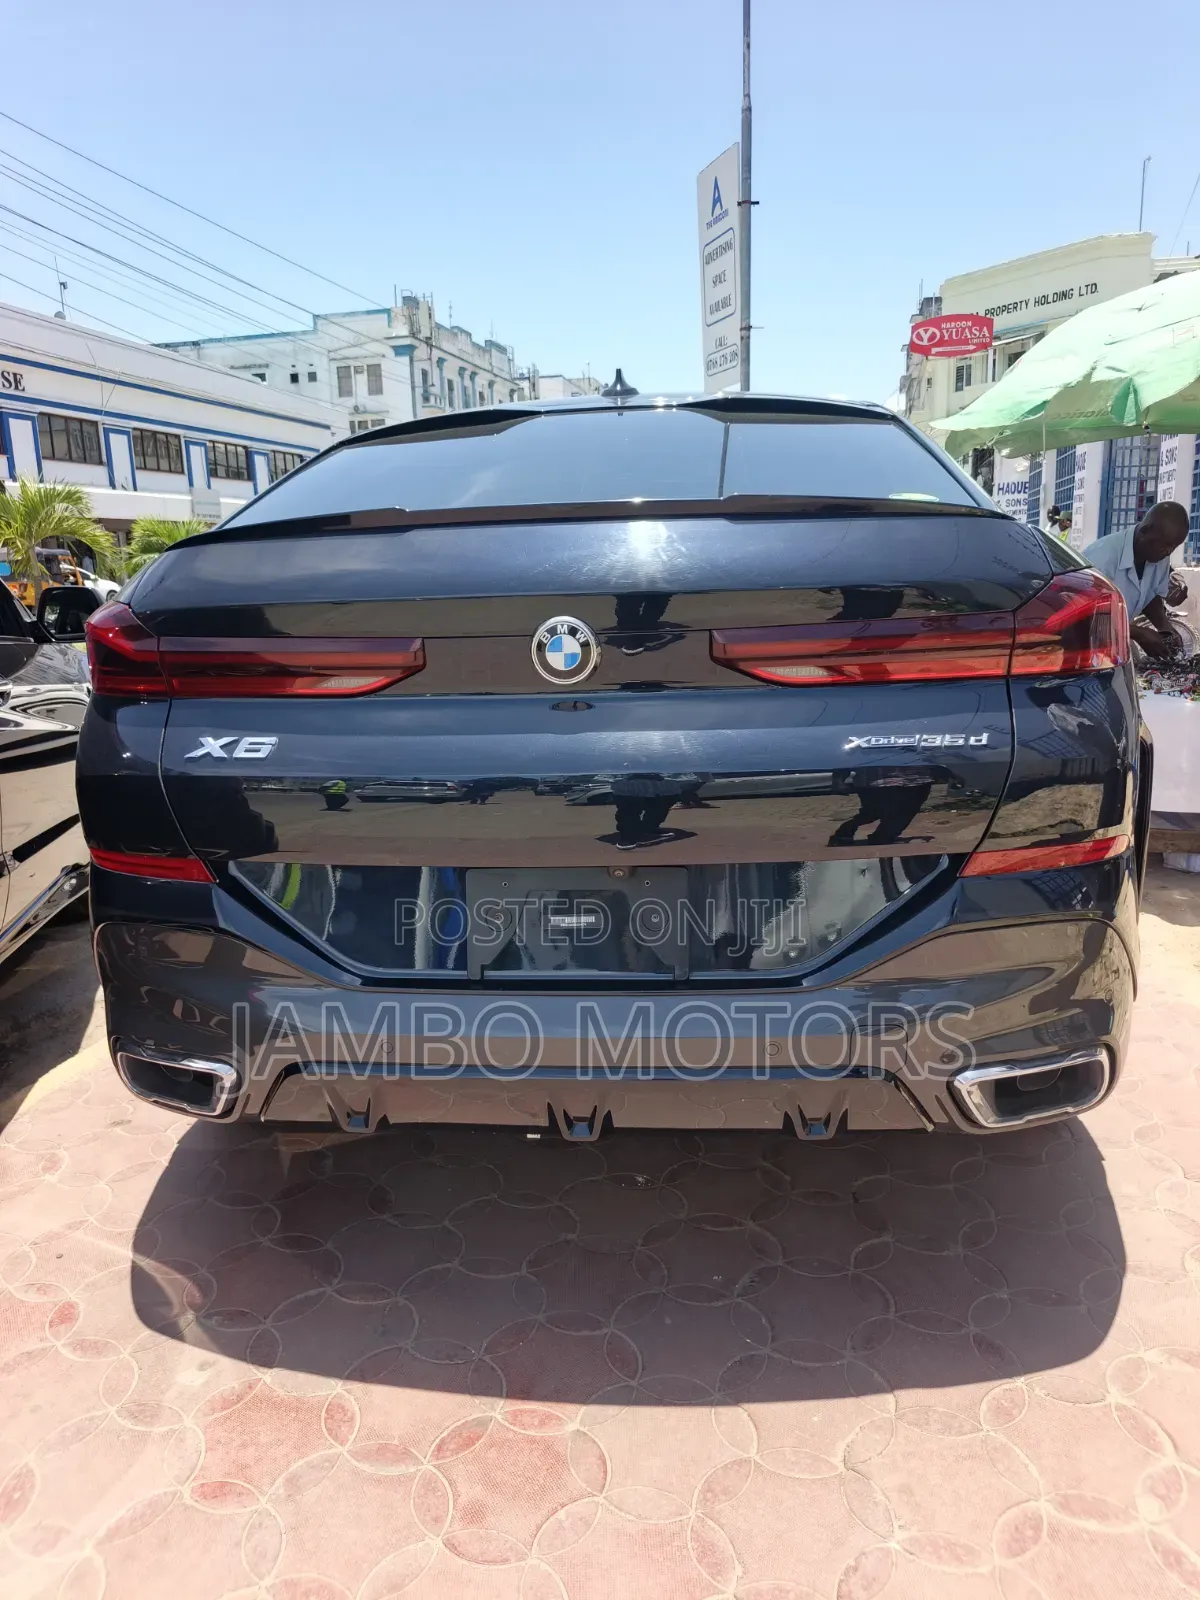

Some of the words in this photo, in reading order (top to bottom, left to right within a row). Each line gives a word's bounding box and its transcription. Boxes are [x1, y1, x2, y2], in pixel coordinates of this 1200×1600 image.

[705, 238, 733, 265] ADVERTISING
[712, 269, 727, 288] SPACE
[709, 293, 732, 316] AVAILABLE
[984, 298, 1030, 318] PROPERTY
[1033, 288, 1074, 307] HOLDING
[1078, 282, 1099, 297] LTD.
[941, 321, 972, 329] HAROON
[941, 326, 990, 340] YUASA
[1, 370, 26, 392] SE
[1005, 497, 1028, 507] SONS
[540, 624, 588, 644] BMW
[183, 736, 279, 759] X6
